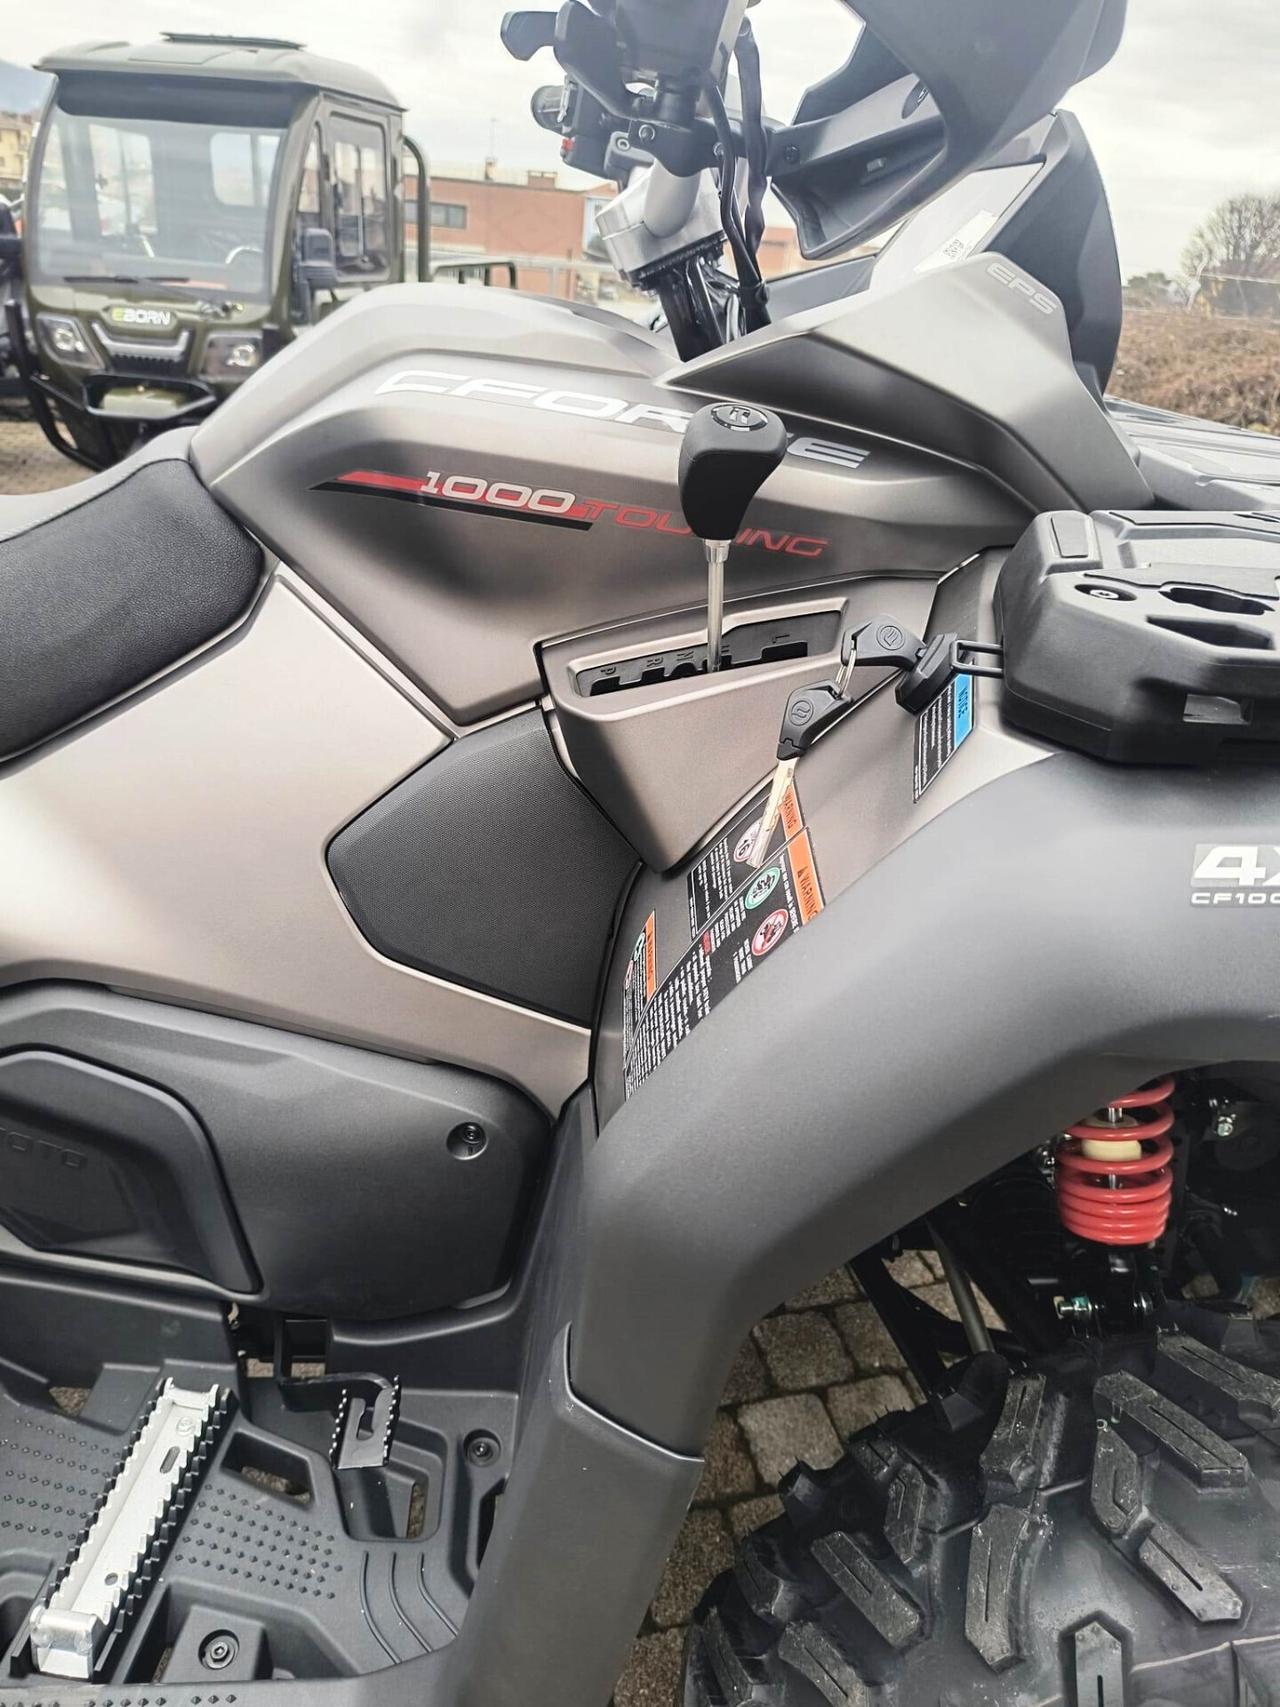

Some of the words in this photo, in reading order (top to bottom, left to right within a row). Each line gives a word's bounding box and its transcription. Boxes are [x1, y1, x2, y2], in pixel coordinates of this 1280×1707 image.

[111, 307, 170, 326] EBORN
[987, 263, 1057, 314] EPS
[375, 370, 871, 468] CFORE
[420, 471, 576, 514] 1000
[583, 499, 829, 558] TOUING
